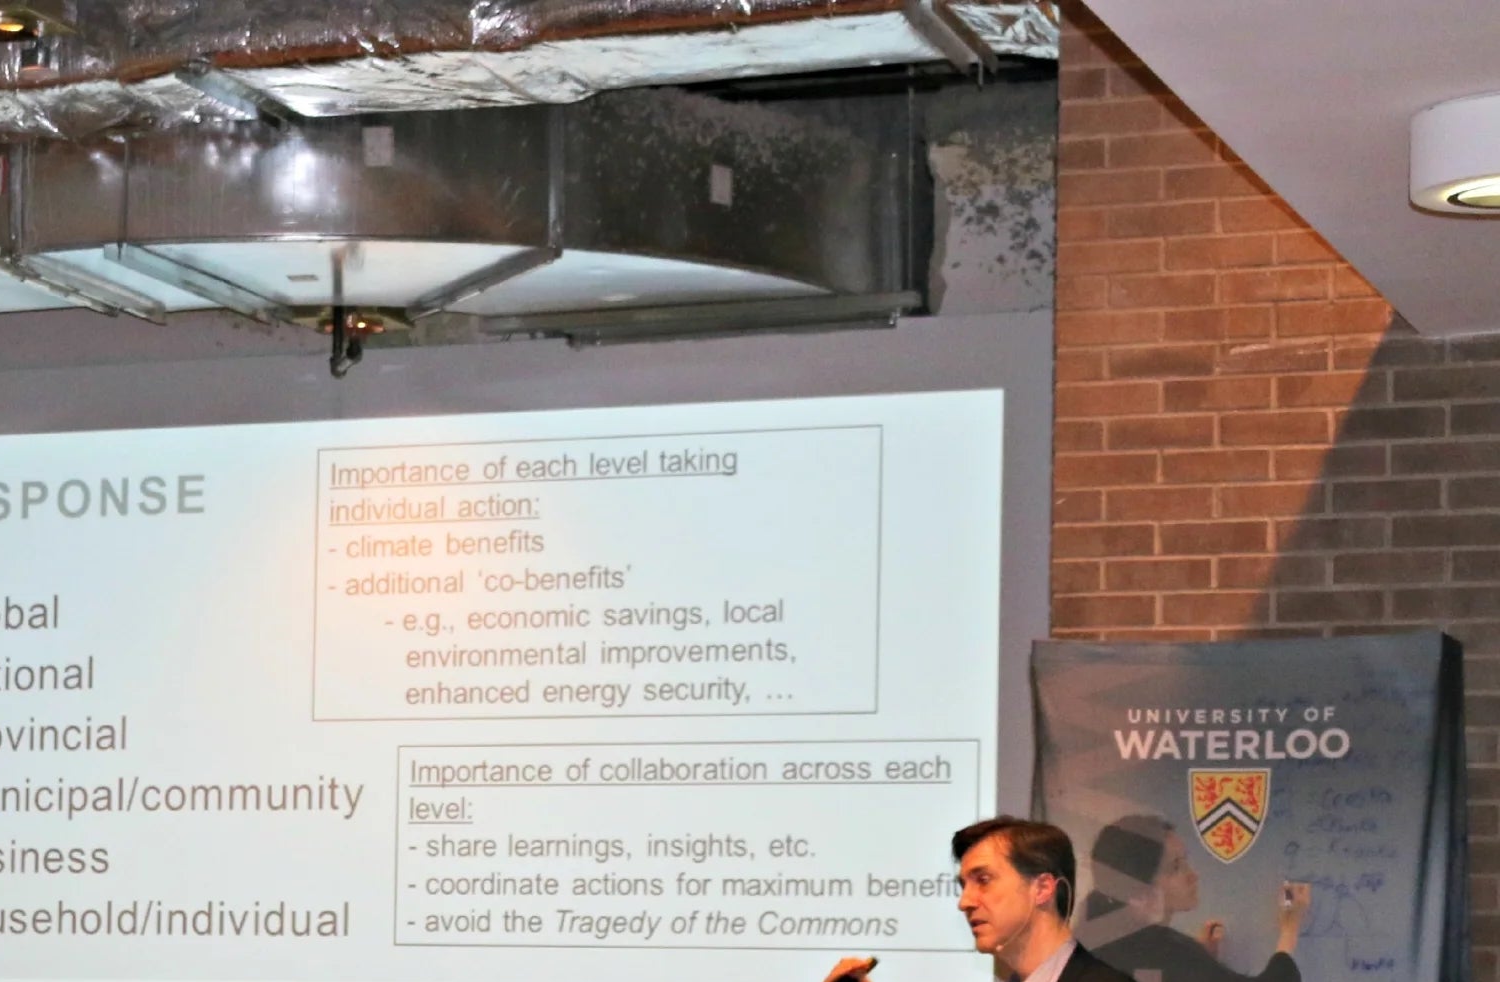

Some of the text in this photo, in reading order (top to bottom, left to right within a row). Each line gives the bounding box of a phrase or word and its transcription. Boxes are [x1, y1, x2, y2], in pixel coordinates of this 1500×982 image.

[330, 449, 738, 488] Importance of each level taking
[330, 495, 540, 524] individual action:
[346, 531, 544, 558] climate benefits
[345, 570, 464, 597] additional
[402, 599, 784, 636] e.g., economic savings, local
[406, 639, 797, 669] environmental improvements,
[405, 682, 530, 706] enhanced
[542, 684, 630, 707] energy
[643, 679, 751, 705] security,
[1128, 706, 1335, 724] UNIVERSITY OF
[1114, 728, 1350, 760] WATERLOO
[410, 755, 951, 786] Importance of collaboration across each
[409, 797, 473, 821] level:
[426, 834, 816, 862] share learnings, insights, etc.
[425, 873, 559, 896] coordinate
[572, 873, 664, 897] actions
[676, 873, 709, 897] for
[722, 874, 853, 898] maximum
[424, 910, 898, 939] avoid the Tragedy of the Commons
